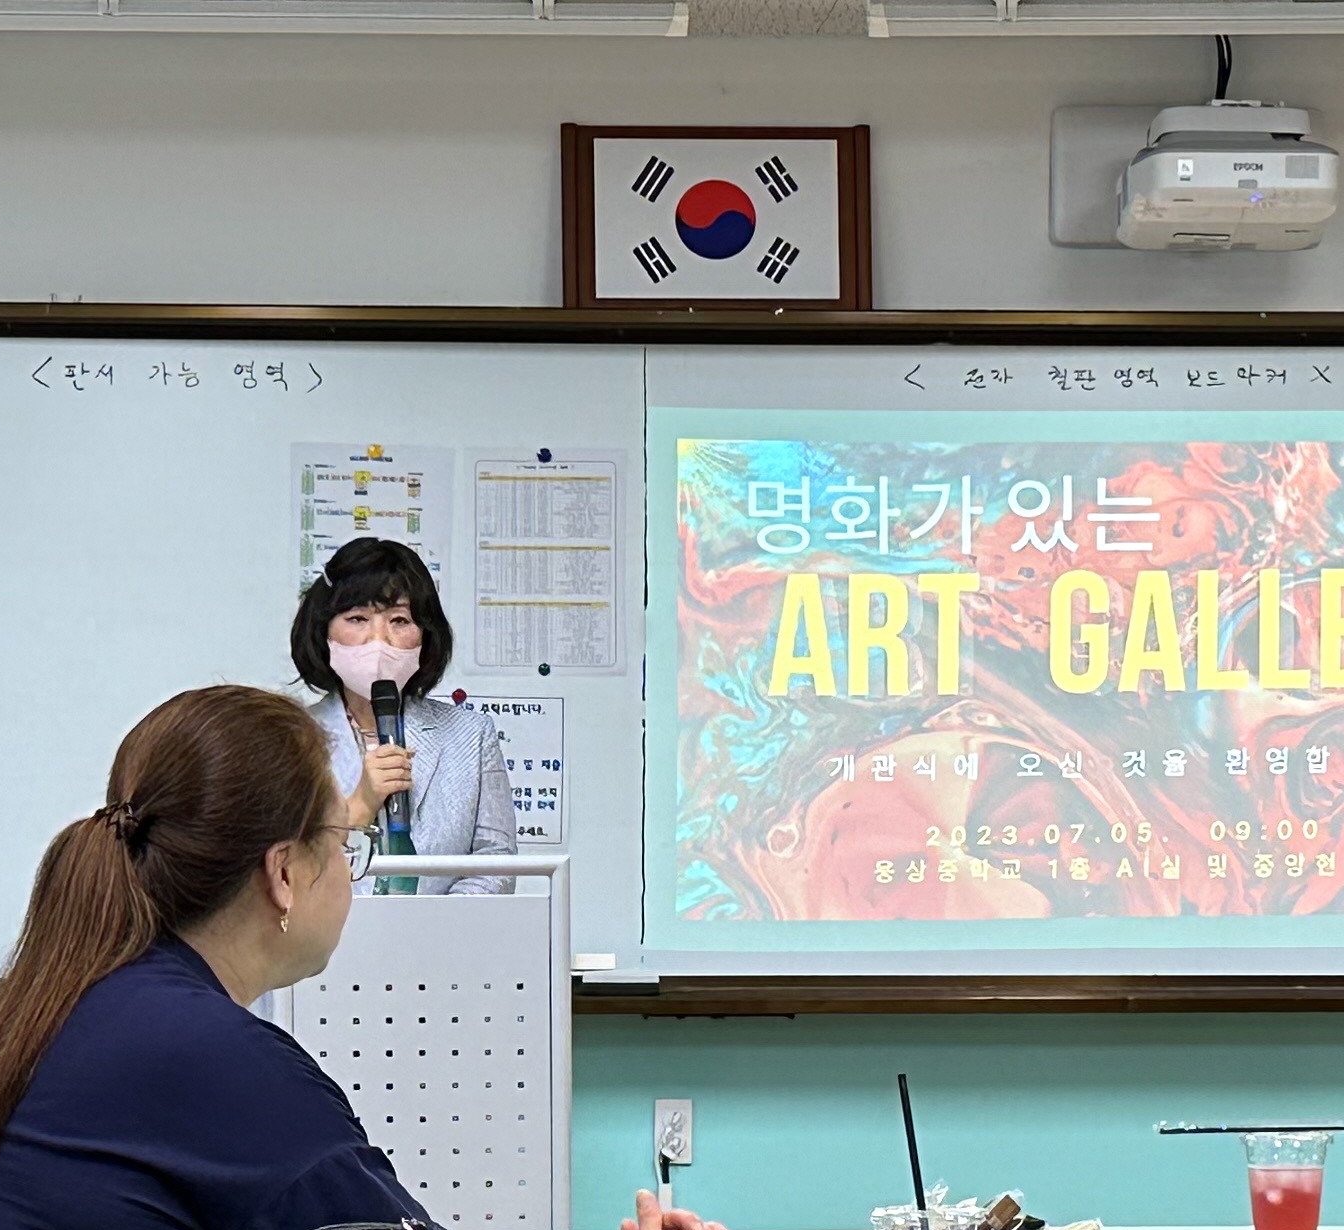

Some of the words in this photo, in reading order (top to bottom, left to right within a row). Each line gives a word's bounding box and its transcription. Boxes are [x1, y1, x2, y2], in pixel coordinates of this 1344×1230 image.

[149, 361, 200, 388] 가능
[964, 367, 1013, 389] 전자
[1114, 366, 1159, 388] 영역
[1187, 368, 1226, 388] 보드
[1237, 364, 1286, 386] 마커
[745, 475, 983, 555] 명화가
[1008, 475, 1161, 555] 있는
[767, 572, 980, 697] ART
[829, 752, 979, 782] 개관식에
[1017, 752, 1083, 778] 오신
[1122, 749, 1187, 778] 것을
[926, 822, 1169, 847] 2023.07.05.
[1210, 819, 1319, 841] 09:00
[1048, 857, 1090, 881] 1층
[1208, 853, 1227, 878] 및
